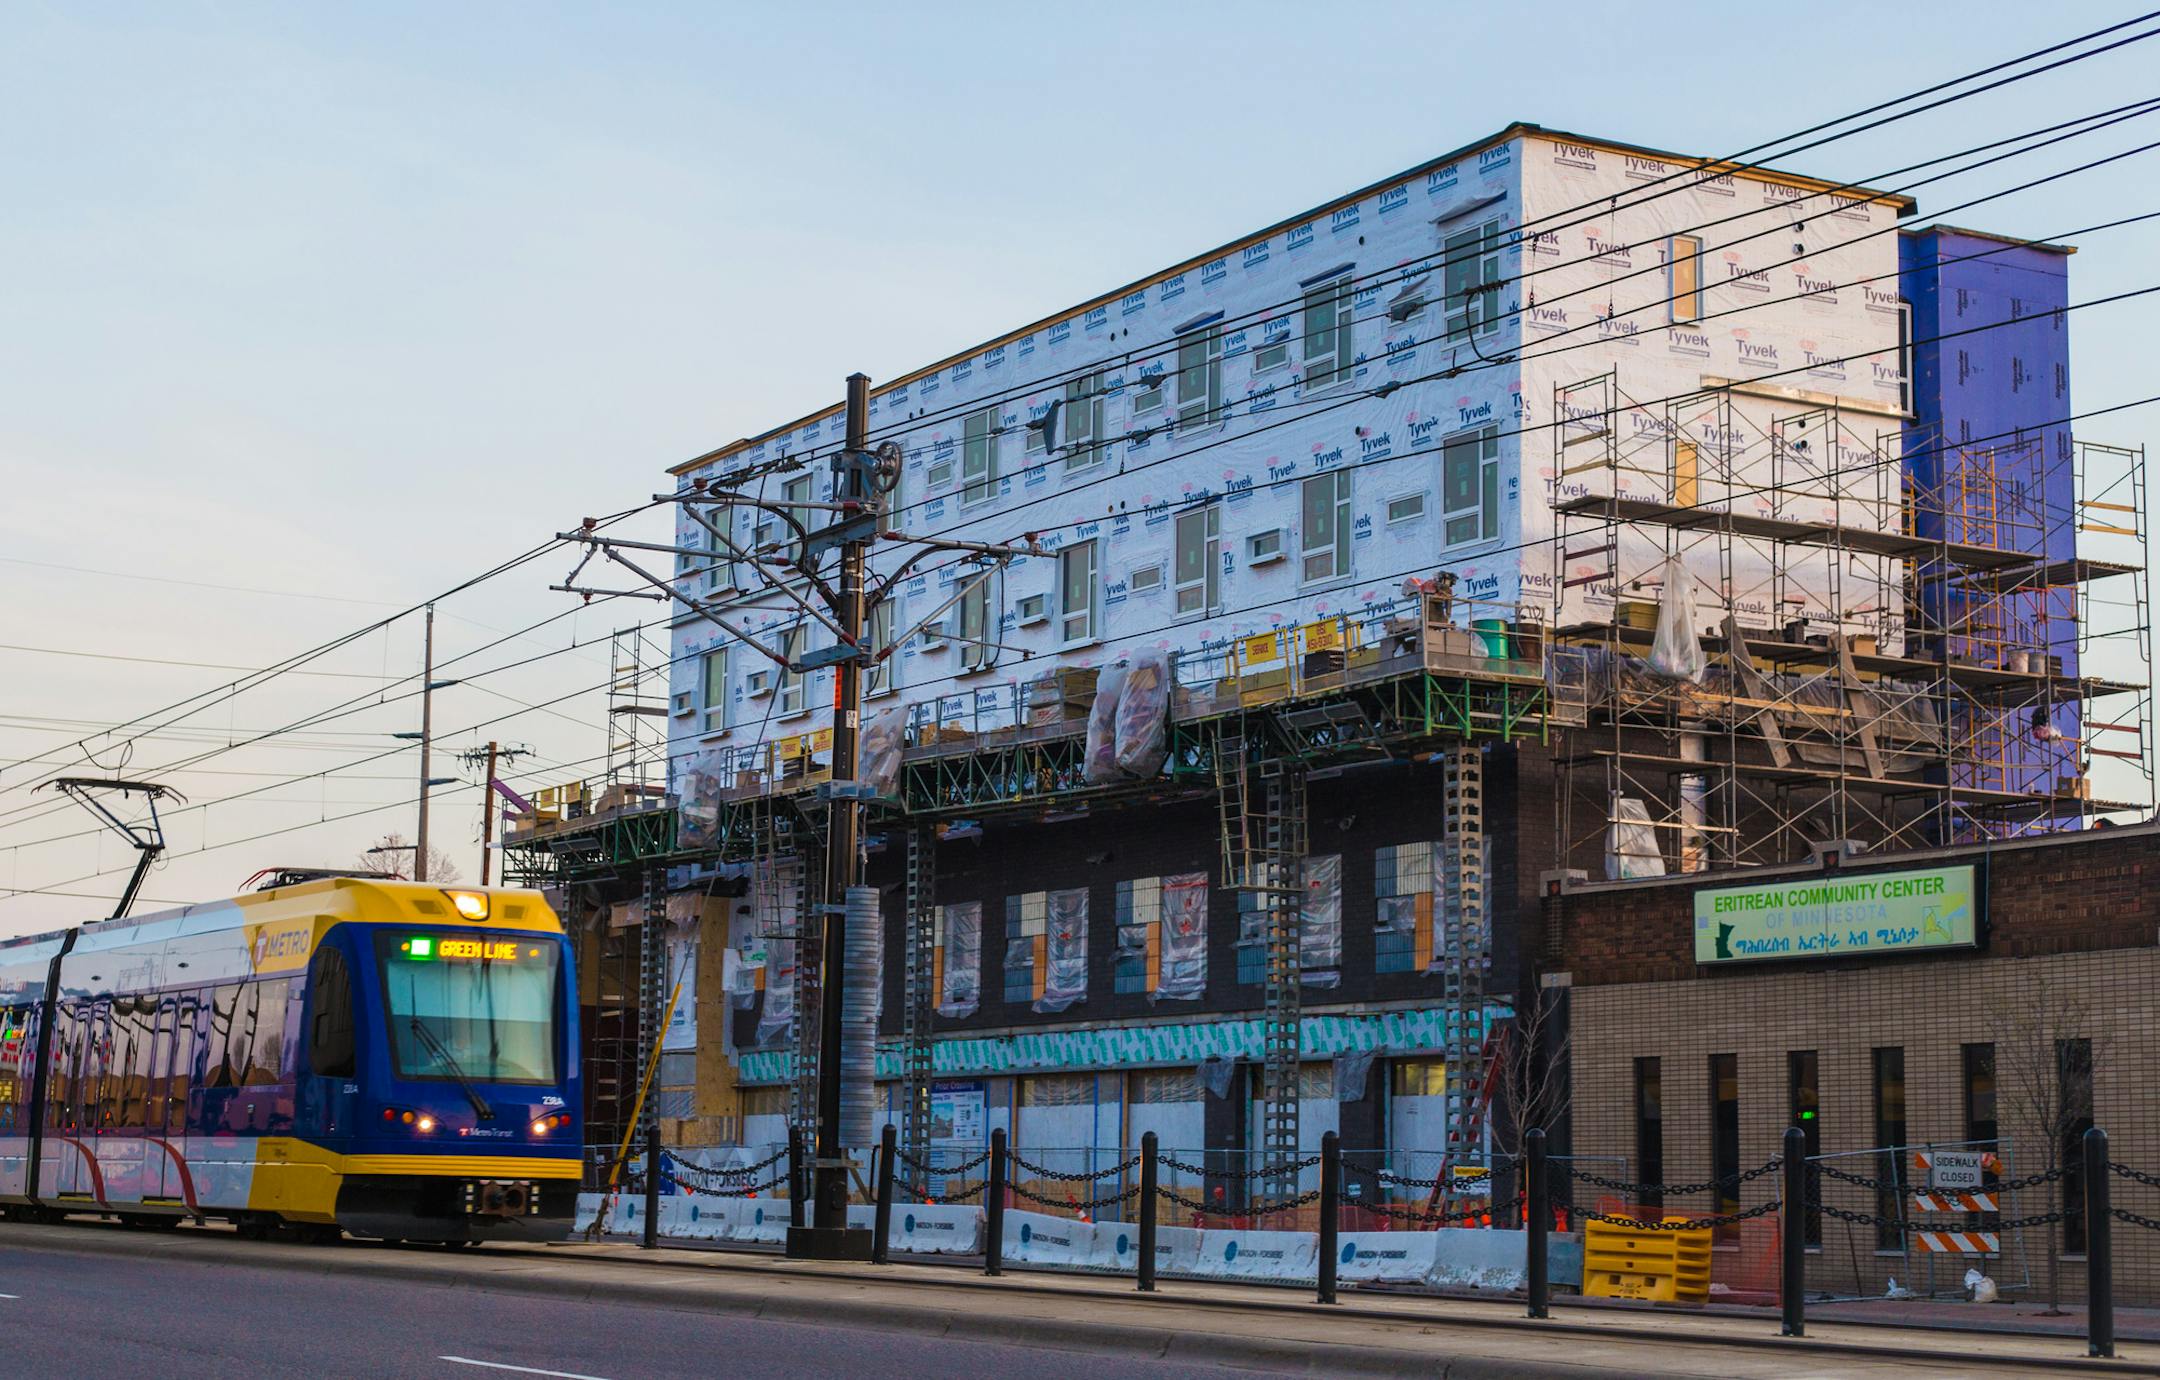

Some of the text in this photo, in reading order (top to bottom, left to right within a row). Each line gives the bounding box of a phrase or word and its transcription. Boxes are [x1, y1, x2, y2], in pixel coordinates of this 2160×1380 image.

[1479, 143, 1511, 164] Tyvek
[1554, 142, 1596, 161] Tyvek
[1428, 164, 1458, 185] Tyvek
[1624, 156, 1665, 174] Tyvek
[1379, 184, 1408, 204] Tyvek
[1763, 182, 1801, 199] Tyvek
[1331, 203, 1360, 224] Tyvek
[1287, 222, 1314, 241] Tyvek
[1243, 240, 1270, 259] Tyvek
[1587, 237, 1631, 258] Tyvek
[1201, 258, 1227, 276] Tyvek
[1727, 262, 1770, 283] Tyvek
[1795, 274, 1838, 294] Tyvek
[1667, 327, 1710, 347] Tyvek
[1736, 340, 1778, 359] Tyvek
[1459, 402, 1491, 424] Tyvek
[1360, 432, 1391, 453] Tyvek
[1313, 447, 1343, 467] Tyvek
[1225, 475, 1253, 494] Tyvek
[1075, 520, 1100, 538] Tyvek
[1465, 573, 1499, 594] Tyvek
[942, 698, 963, 714] Tyvek
[976, 690, 997, 707] Tyvek
[1714, 876, 1944, 913] ERITREAN COMMUNITY CENTER
[1766, 904, 1887, 929] OF MINNESOTA
[269, 929, 309, 956] METRO
[440, 940, 517, 959] GREEN LINE
[1935, 1157, 1979, 1168] SIDEWALK
[1940, 1172, 1975, 1183] CLOSED
